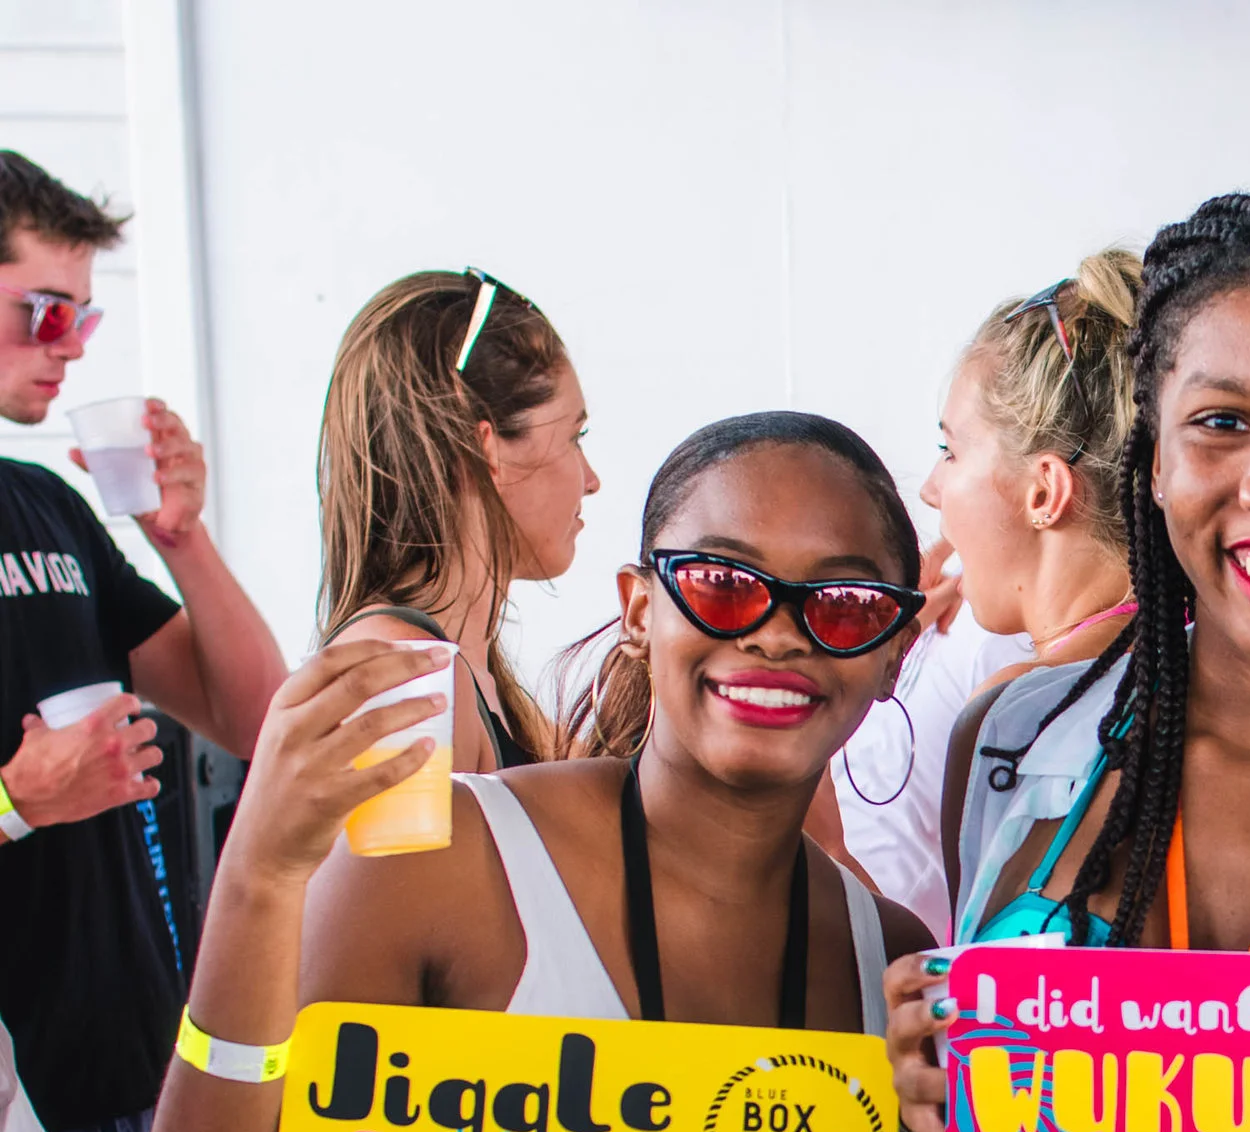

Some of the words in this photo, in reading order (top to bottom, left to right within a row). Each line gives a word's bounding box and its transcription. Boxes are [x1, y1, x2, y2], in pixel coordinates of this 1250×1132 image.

[976, 973, 997, 1024] I
[1016, 975, 1105, 1034] did
[745, 1087, 788, 1101] BLUE
